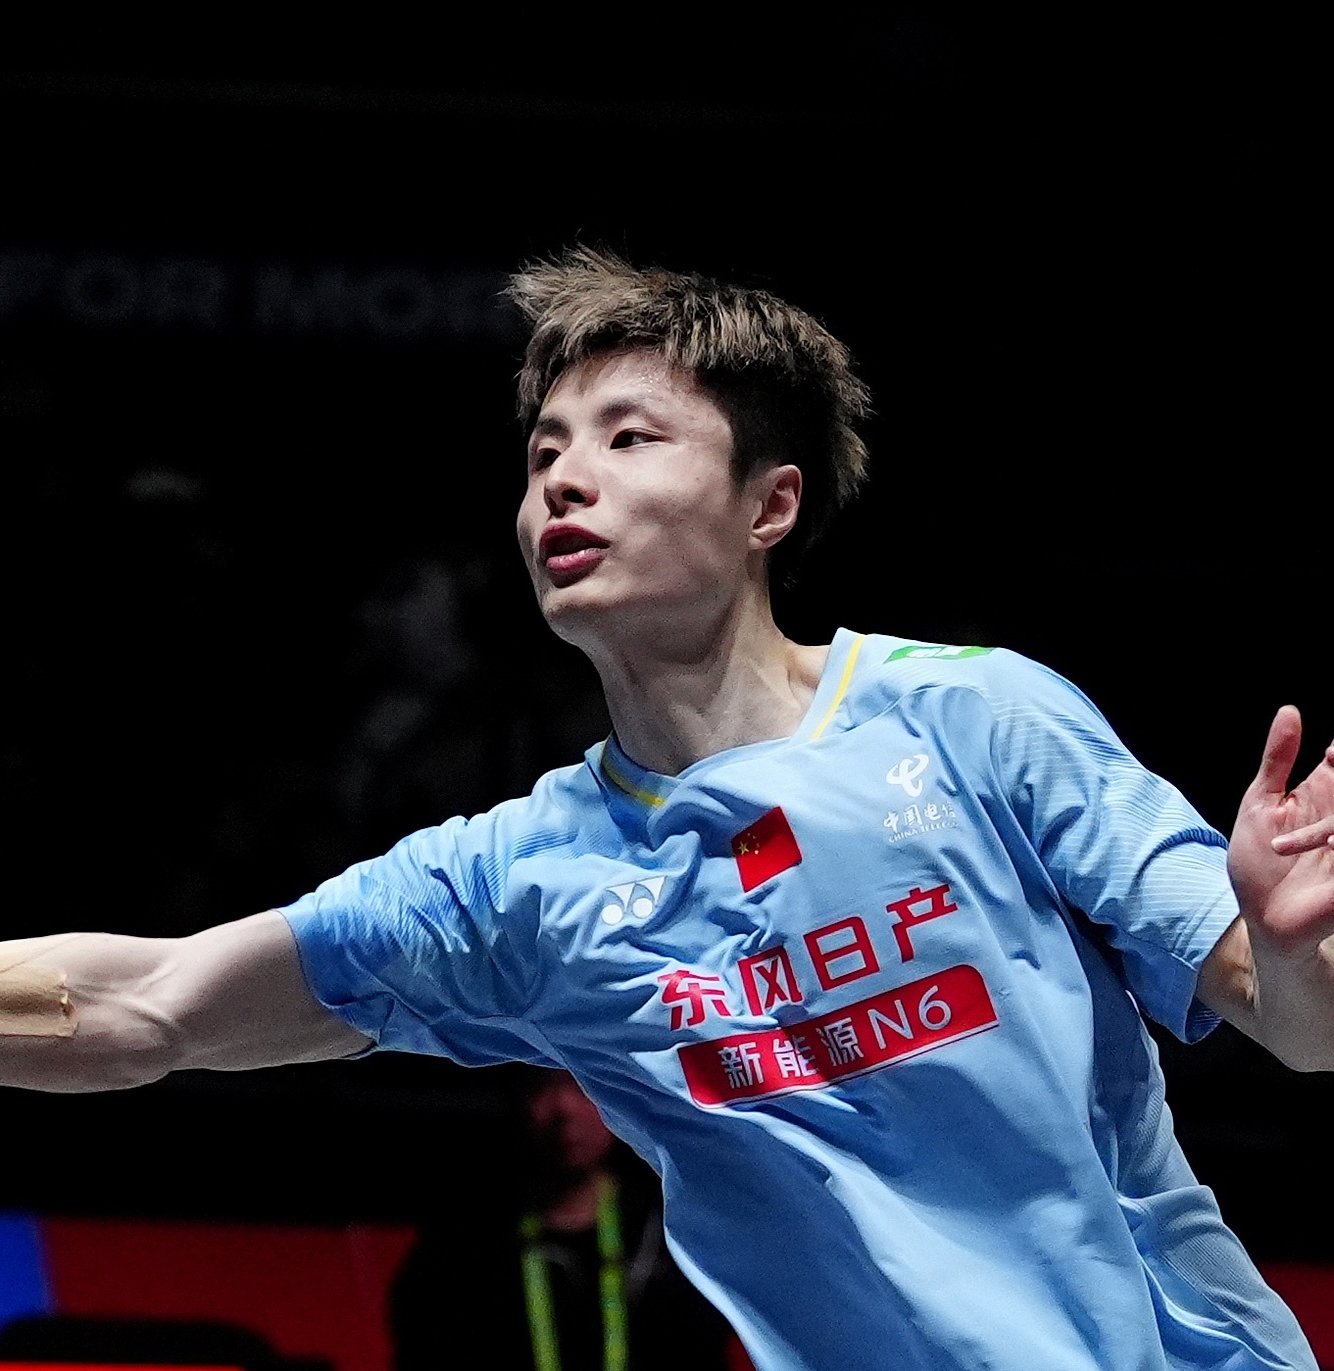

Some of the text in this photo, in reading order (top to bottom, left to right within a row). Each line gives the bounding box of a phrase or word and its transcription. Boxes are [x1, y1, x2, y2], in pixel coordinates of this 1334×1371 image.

[657, 884, 958, 1031] 东风日产
[717, 984, 953, 1089] 新能源N6
